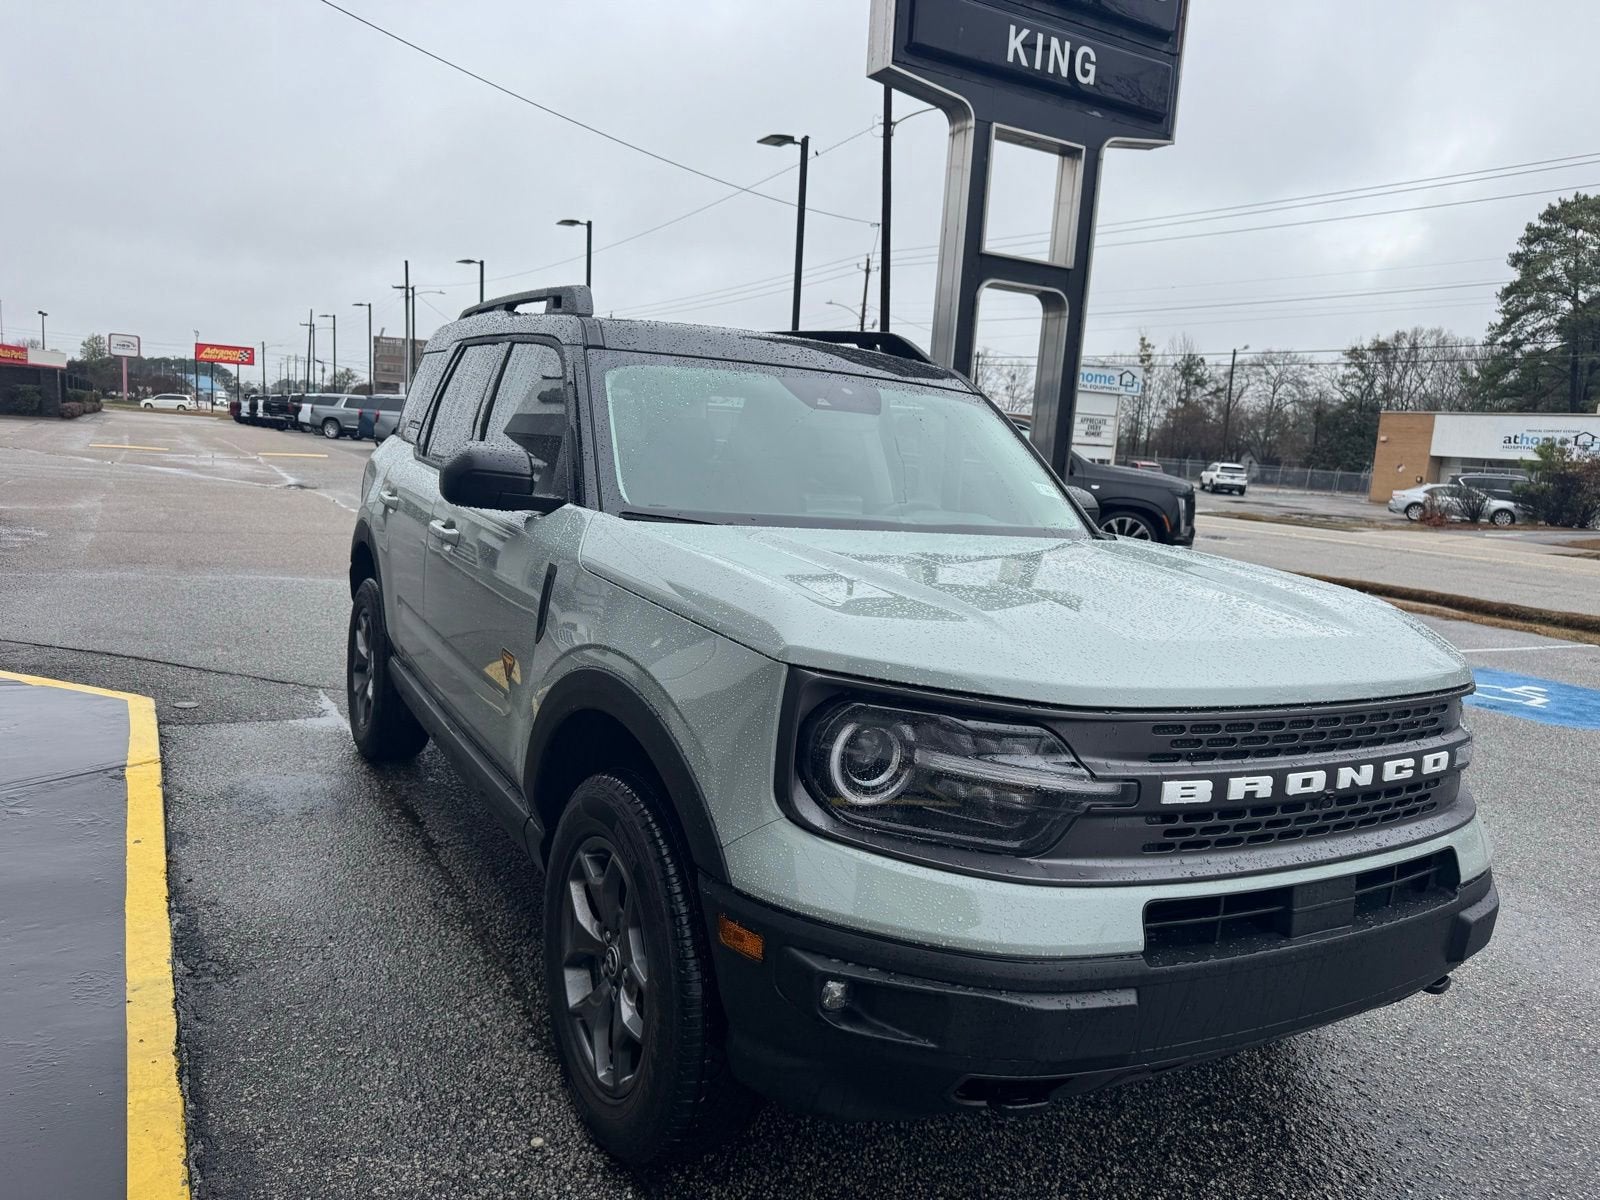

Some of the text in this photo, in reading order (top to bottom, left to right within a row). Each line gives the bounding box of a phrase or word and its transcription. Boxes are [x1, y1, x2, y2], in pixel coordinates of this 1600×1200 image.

[1007, 24, 1097, 86] KING
[203, 347, 238, 356] Advance
[1090, 384, 1120, 392] EQUIPMENT
[1160, 751, 1450, 805] BRONCO
